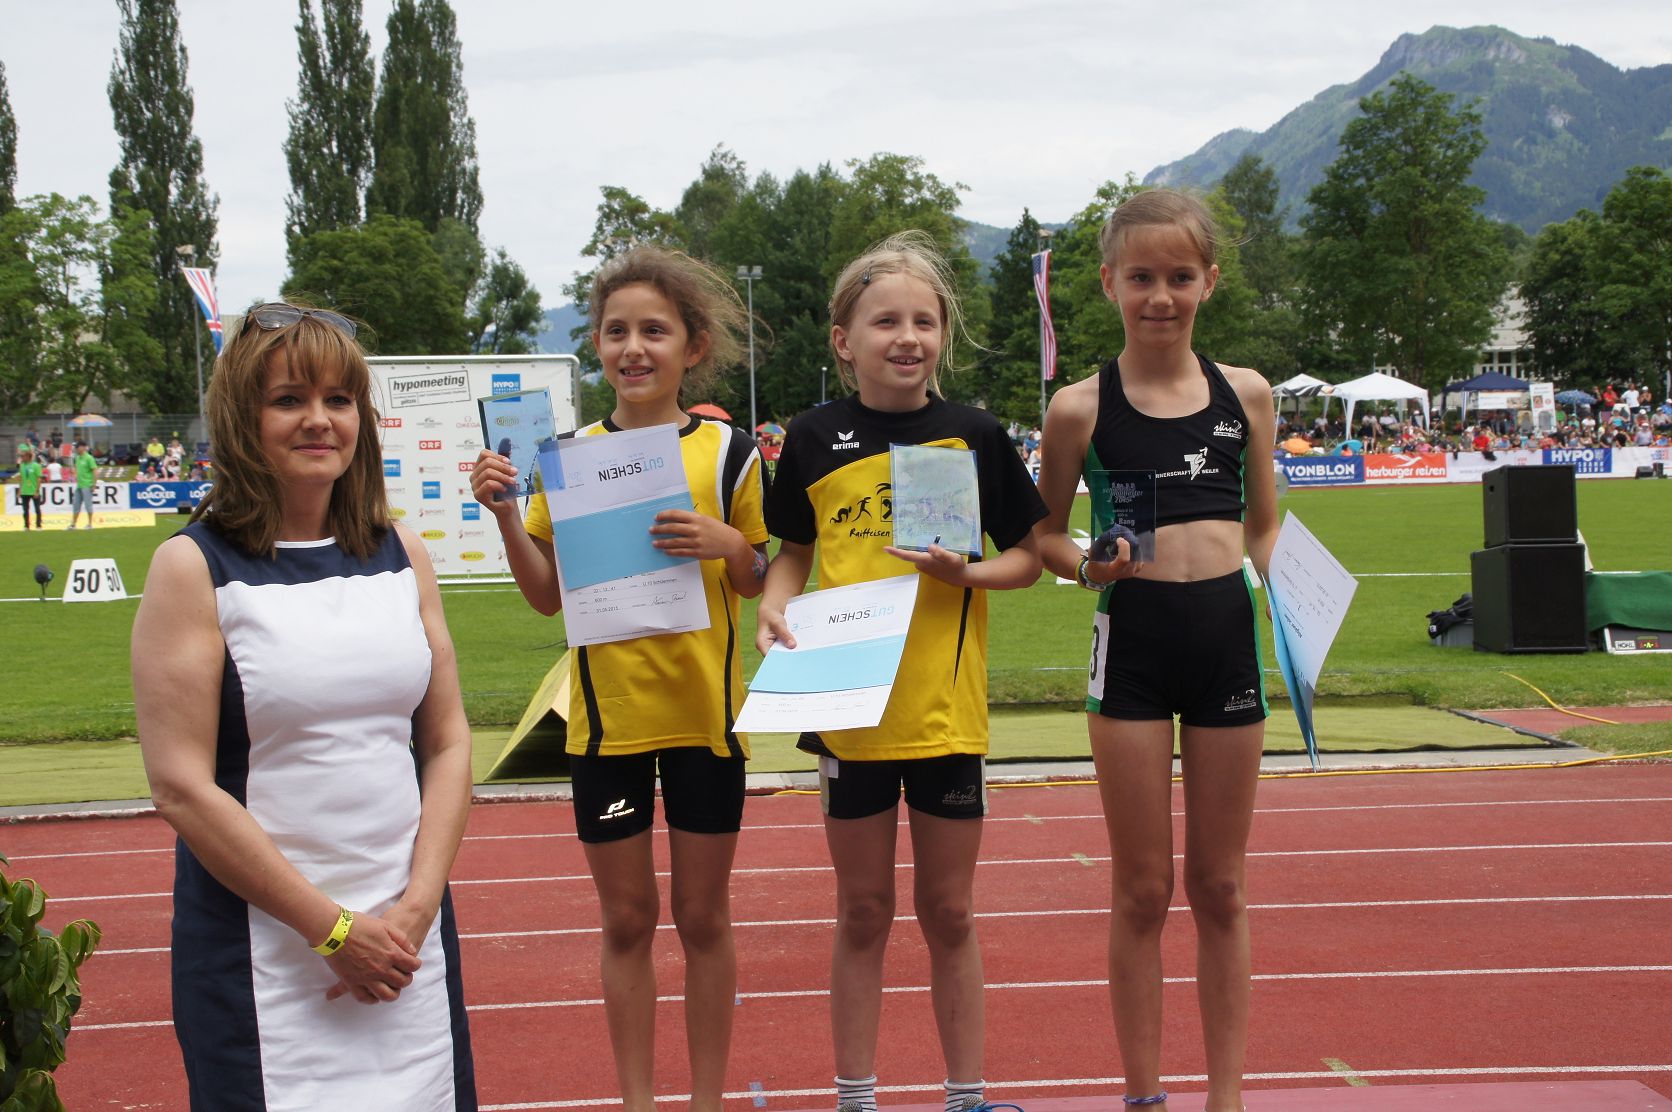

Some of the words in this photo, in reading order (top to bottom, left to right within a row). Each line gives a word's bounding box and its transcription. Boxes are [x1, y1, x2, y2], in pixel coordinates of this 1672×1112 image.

[393, 375, 465, 392] hypomeeting
[381, 419, 401, 427] ORF
[420, 441, 441, 449] ORF
[832, 441, 860, 450] erima
[1551, 450, 1594, 462] HYPO
[598, 456, 664, 482] GUTSCHEIN
[1286, 464, 1355, 477] VONBLON
[1366, 466, 1413, 480] herburger
[1415, 466, 1446, 477] reisen
[137, 490, 176, 499] LOACKER
[850, 528, 890, 537] Raiffeisen
[73, 569, 100, 594] 50
[105, 567, 120, 592] 50
[828, 605, 894, 625] GUTSCHEIN
